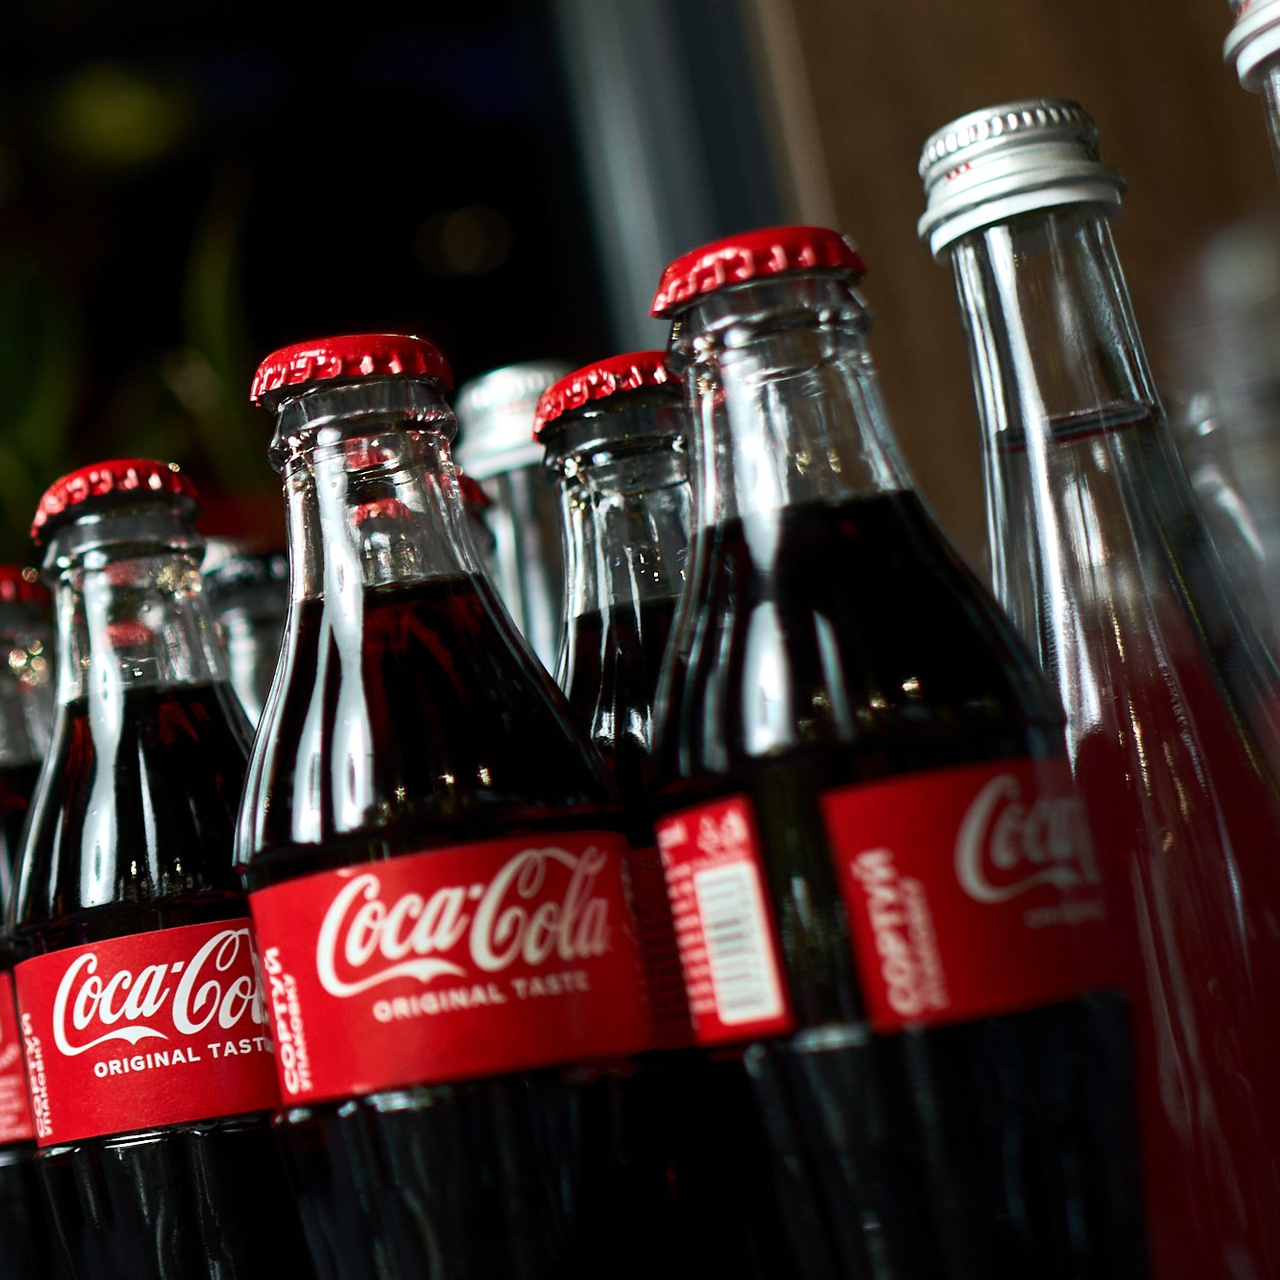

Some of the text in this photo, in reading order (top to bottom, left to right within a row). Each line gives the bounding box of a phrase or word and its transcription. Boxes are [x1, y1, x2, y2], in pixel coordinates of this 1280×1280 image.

[316, 846, 611, 998] Coca-Cola
[263, 947, 300, 1095] СОРТУЙ
[372, 969, 591, 1024] ORIGINAL TASTE
[93, 1047, 201, 1079] ORIGINAL
